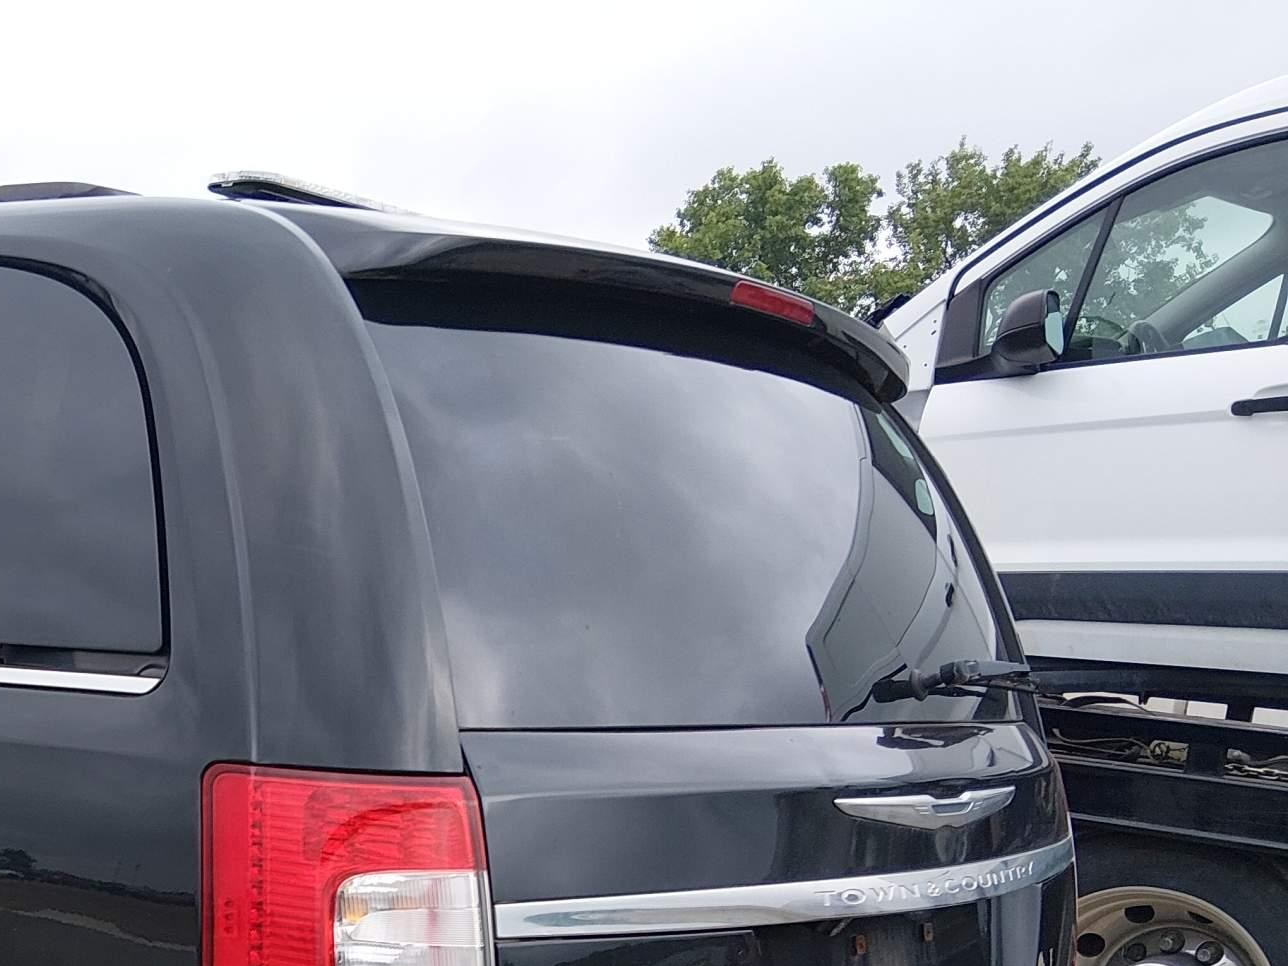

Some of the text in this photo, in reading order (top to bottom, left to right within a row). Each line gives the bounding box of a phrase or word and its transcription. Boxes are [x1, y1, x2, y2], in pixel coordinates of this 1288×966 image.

[814, 861, 1034, 907] TOWN & COUNTRY
